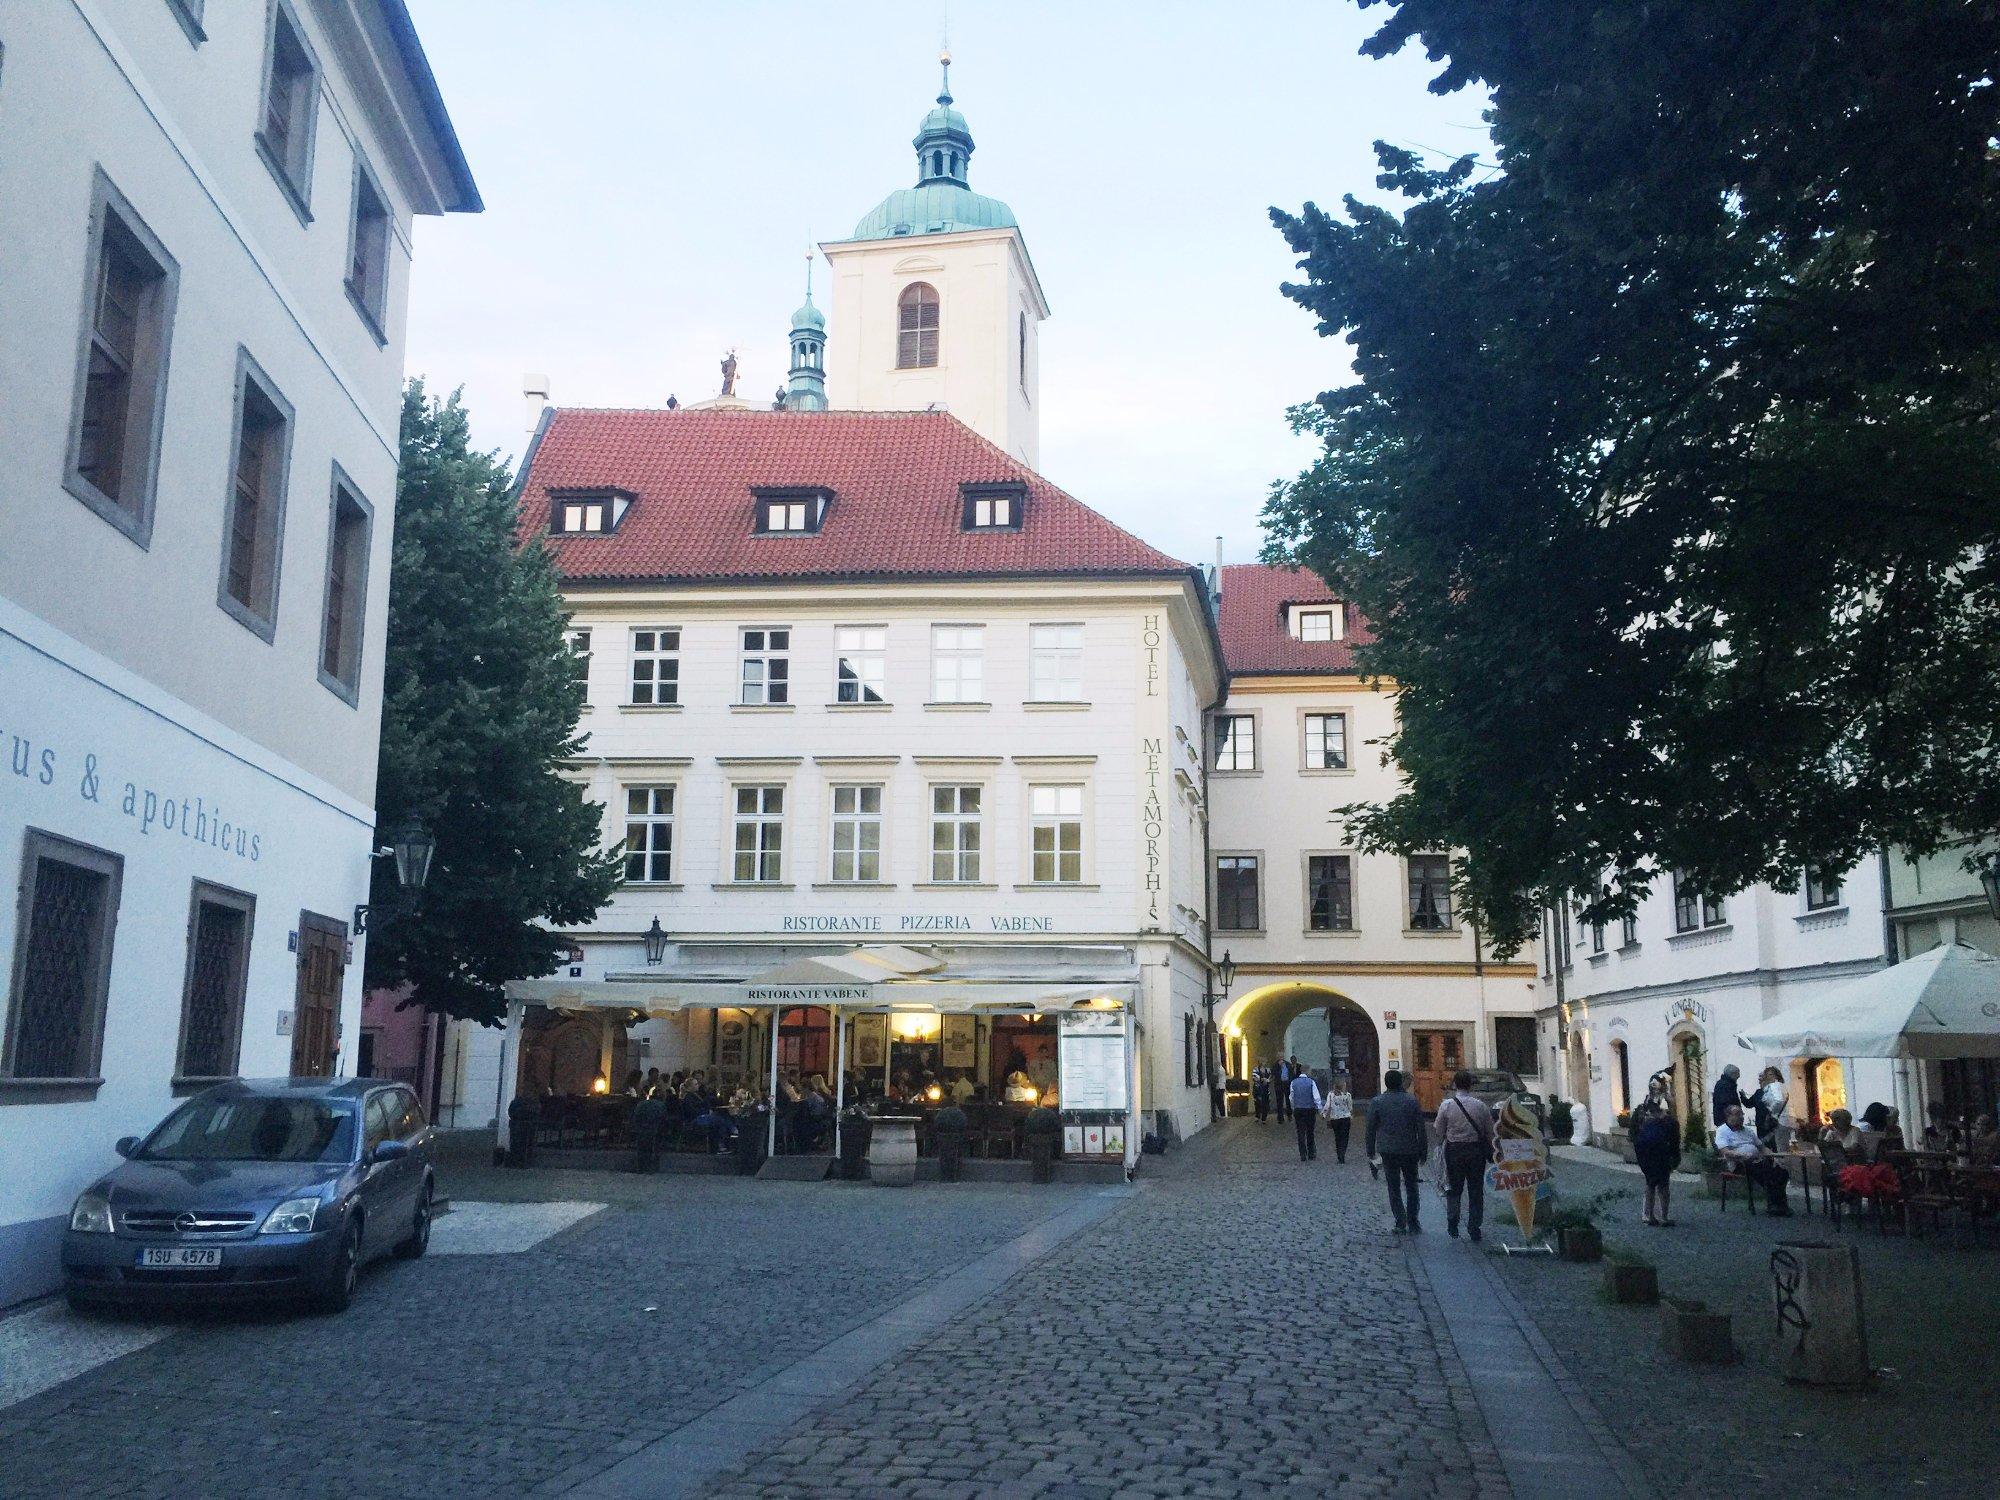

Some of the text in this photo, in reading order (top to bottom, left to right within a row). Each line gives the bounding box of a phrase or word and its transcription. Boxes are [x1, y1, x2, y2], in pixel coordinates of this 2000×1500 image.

[1143, 615, 1162, 921] HOTEL METAMORPHIS
[0, 729, 261, 863] us & apothicus
[782, 915, 1054, 931] RISTORANTE PIZZERIA VABENE
[747, 988, 869, 1000] RISTORANTE VABENE
[148, 1249, 215, 1263] 1SU 4578
